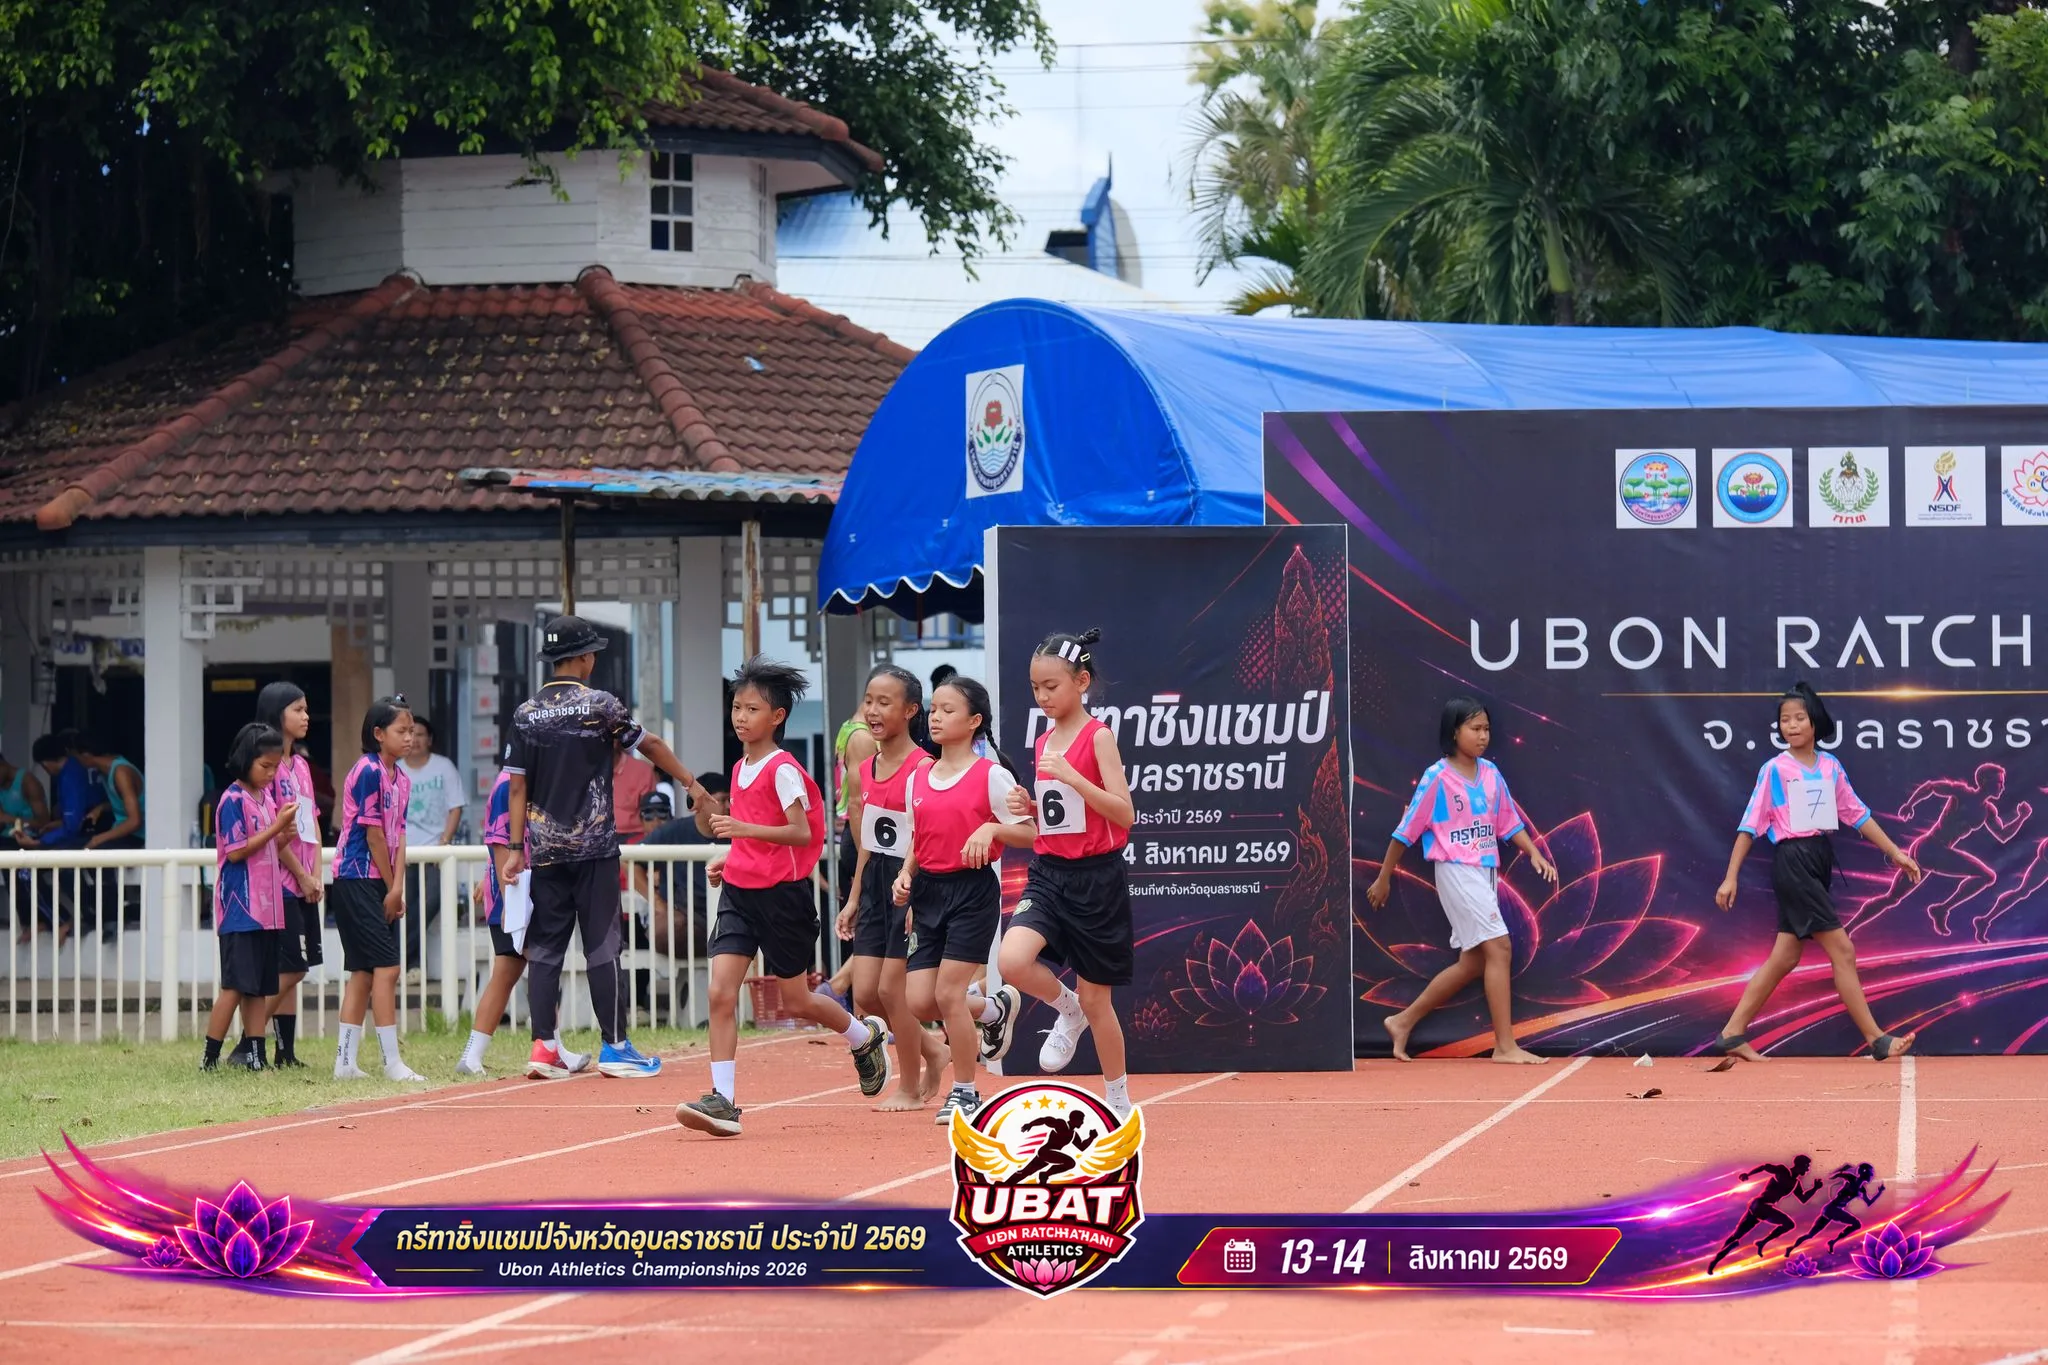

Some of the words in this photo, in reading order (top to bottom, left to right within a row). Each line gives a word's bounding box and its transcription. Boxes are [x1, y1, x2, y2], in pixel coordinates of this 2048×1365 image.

[1928, 504, 1962, 512] NSDF
[1470, 616, 1727, 671] UBON
[1777, 613, 2032, 670] RATCH
[528, 703, 591, 724] อุบลราชธานี
[1122, 751, 1287, 793] บลราชธานี
[1042, 789, 1065, 827] 6
[1453, 794, 1464, 812] 5
[1806, 789, 1826, 820] 7
[251, 815, 259, 831] 7
[1186, 809, 1223, 824] 2569
[874, 816, 897, 848] 6
[1121, 842, 1137, 865] 4
[1145, 841, 1228, 865] สิงหาคม
[1235, 841, 1291, 864] 2569
[1128, 881, 1261, 898] รียนกีฬาจังหวัดอุบลราชธานี
